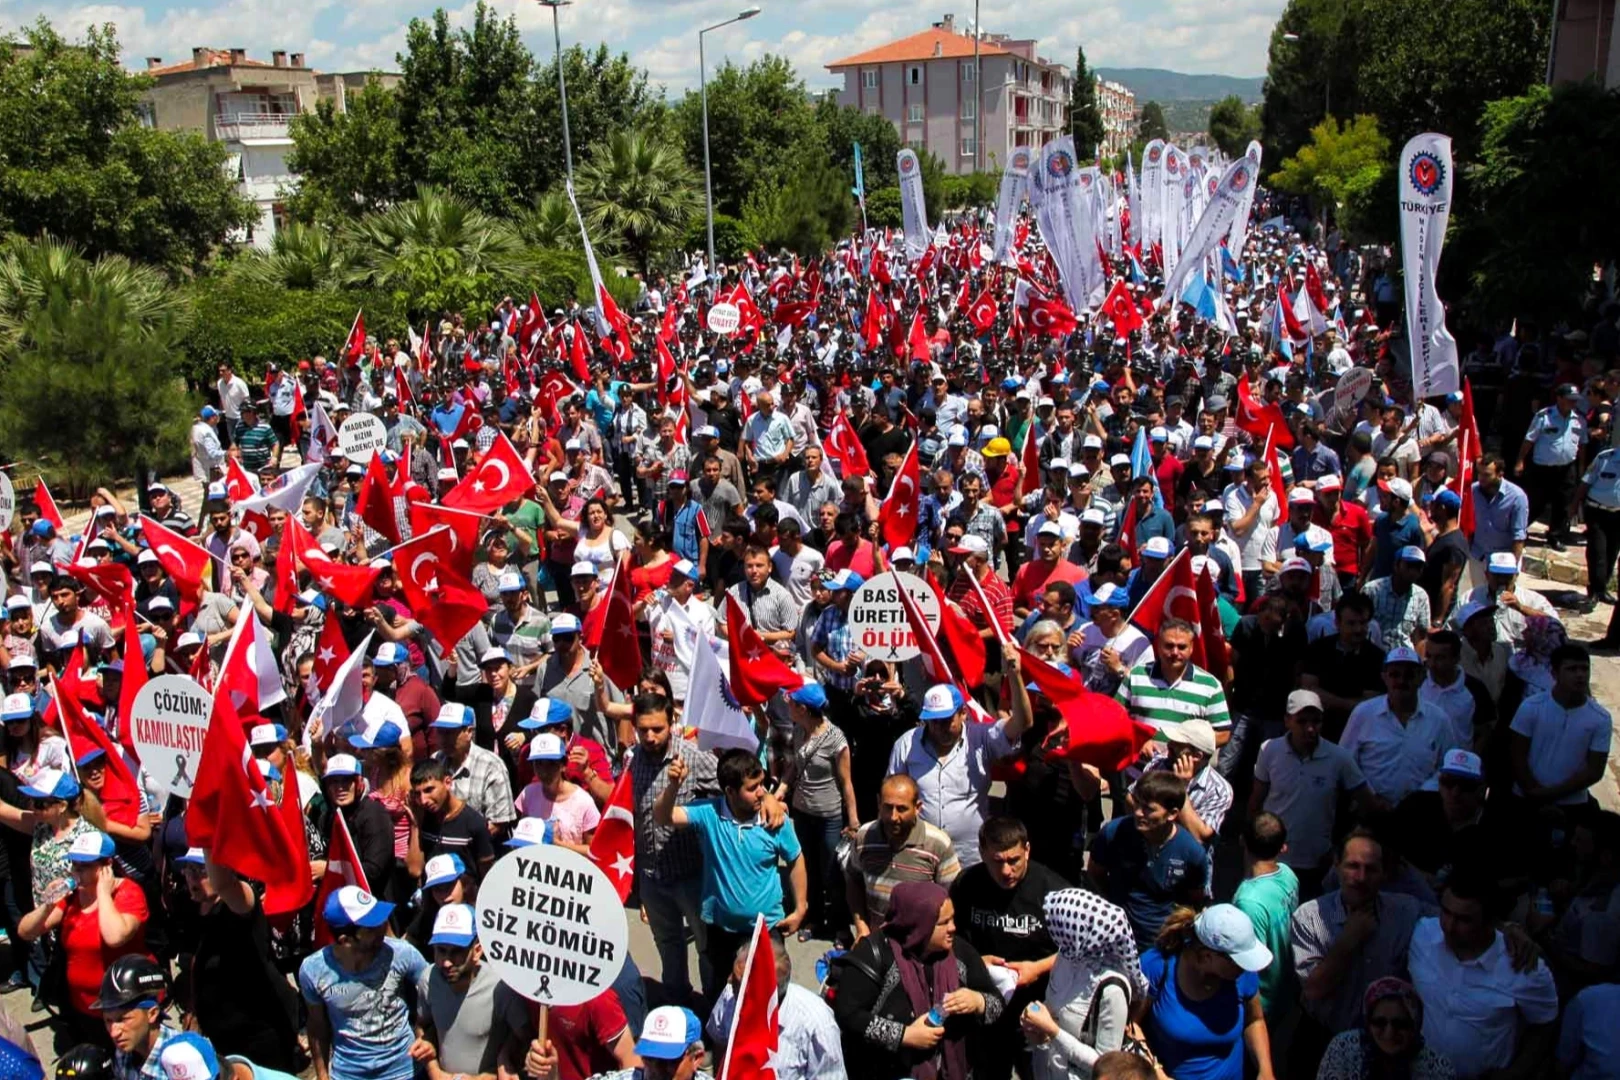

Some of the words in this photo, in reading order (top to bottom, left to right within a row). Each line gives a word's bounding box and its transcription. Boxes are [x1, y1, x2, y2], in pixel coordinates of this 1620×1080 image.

[1401, 200, 1446, 215] TÜRKİYE
[345, 418, 375, 432] MADENDE
[375, 438, 384, 447] DE
[154, 688, 207, 720] ÇÖZÜM;
[516, 856, 593, 895] YANAN
[511, 886, 592, 926] BİZDİK
[482, 908, 518, 935] SİZ
[526, 920, 615, 962] KÖMÜR
[489, 940, 601, 987] SANDINIZ
